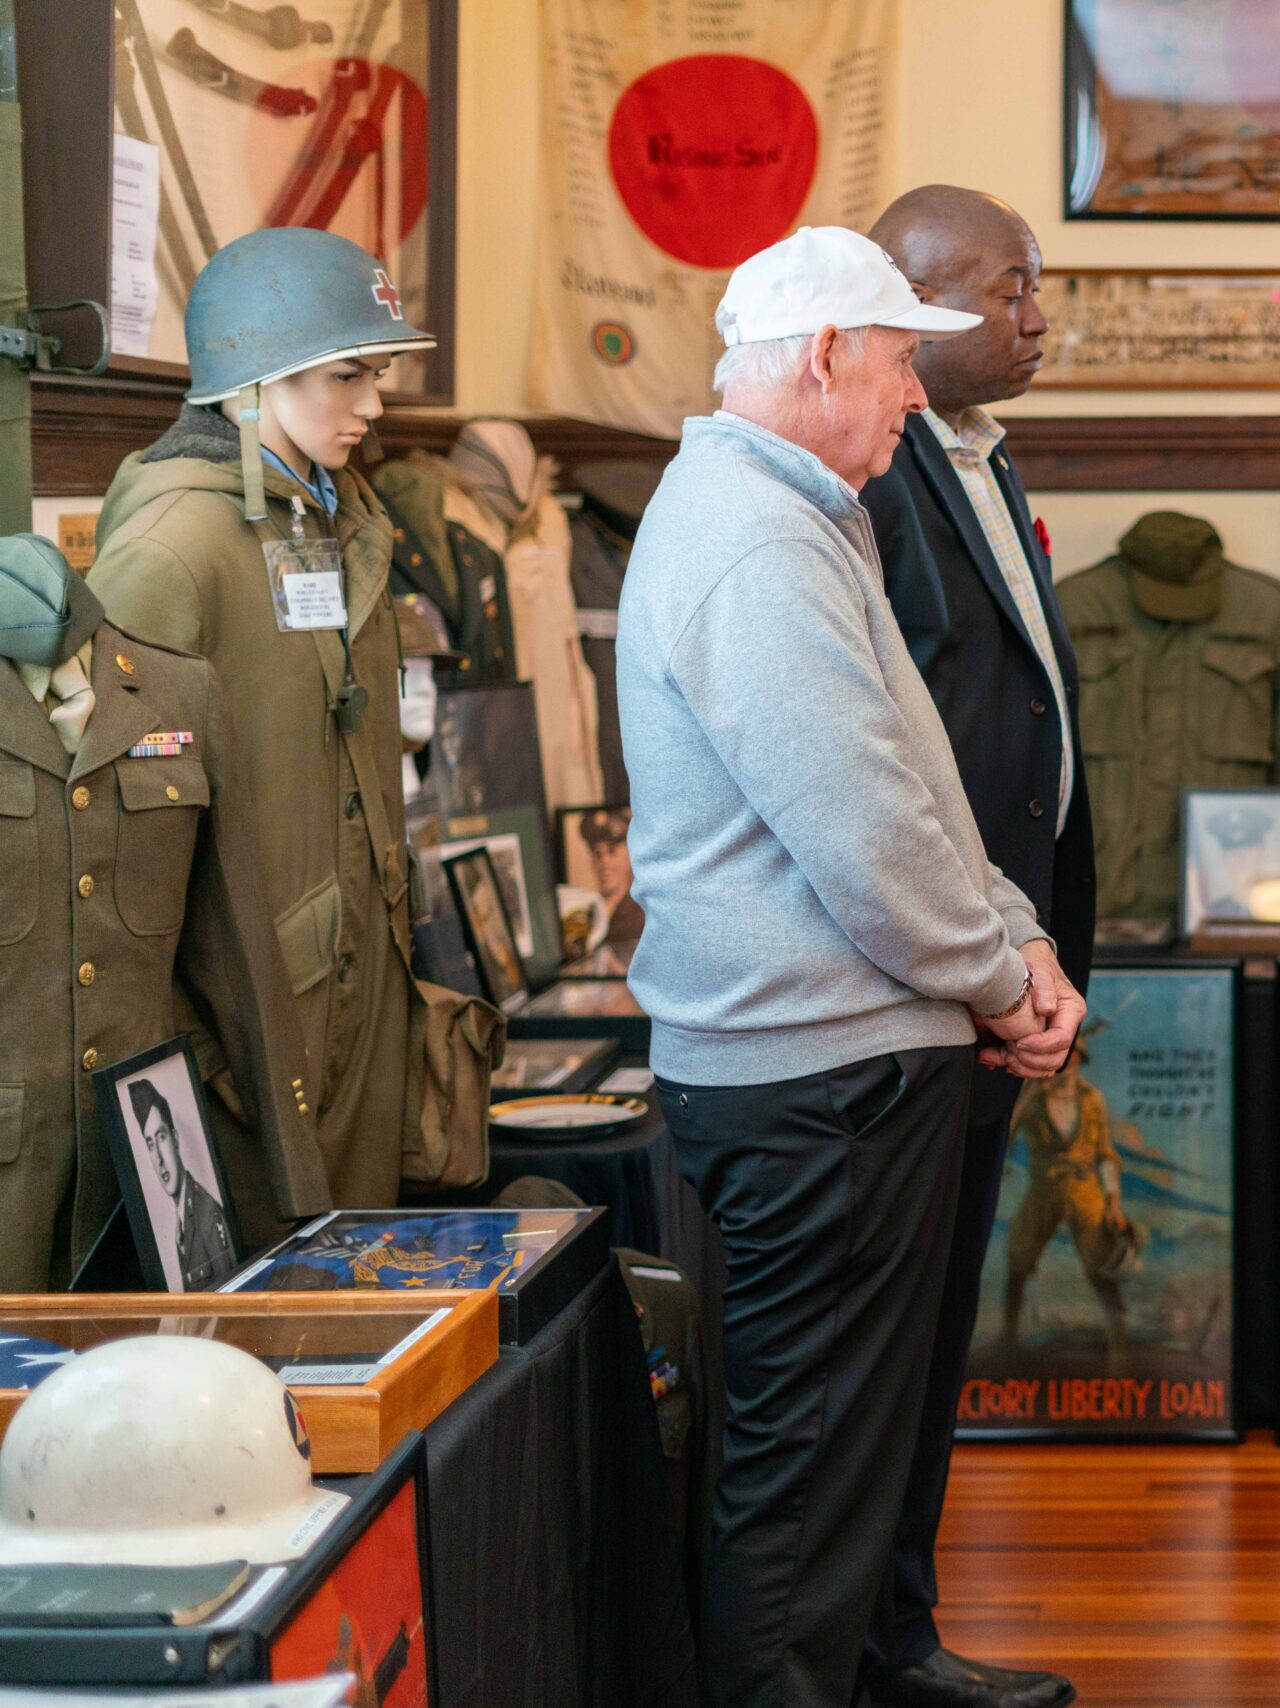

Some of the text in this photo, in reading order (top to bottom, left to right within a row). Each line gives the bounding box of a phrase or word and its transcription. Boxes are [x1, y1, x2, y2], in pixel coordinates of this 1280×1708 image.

[1128, 1101, 1216, 1118] FIGHT
[1048, 1378, 1153, 1420] LIBERTY
[1160, 1379, 1226, 1419] LOAN
